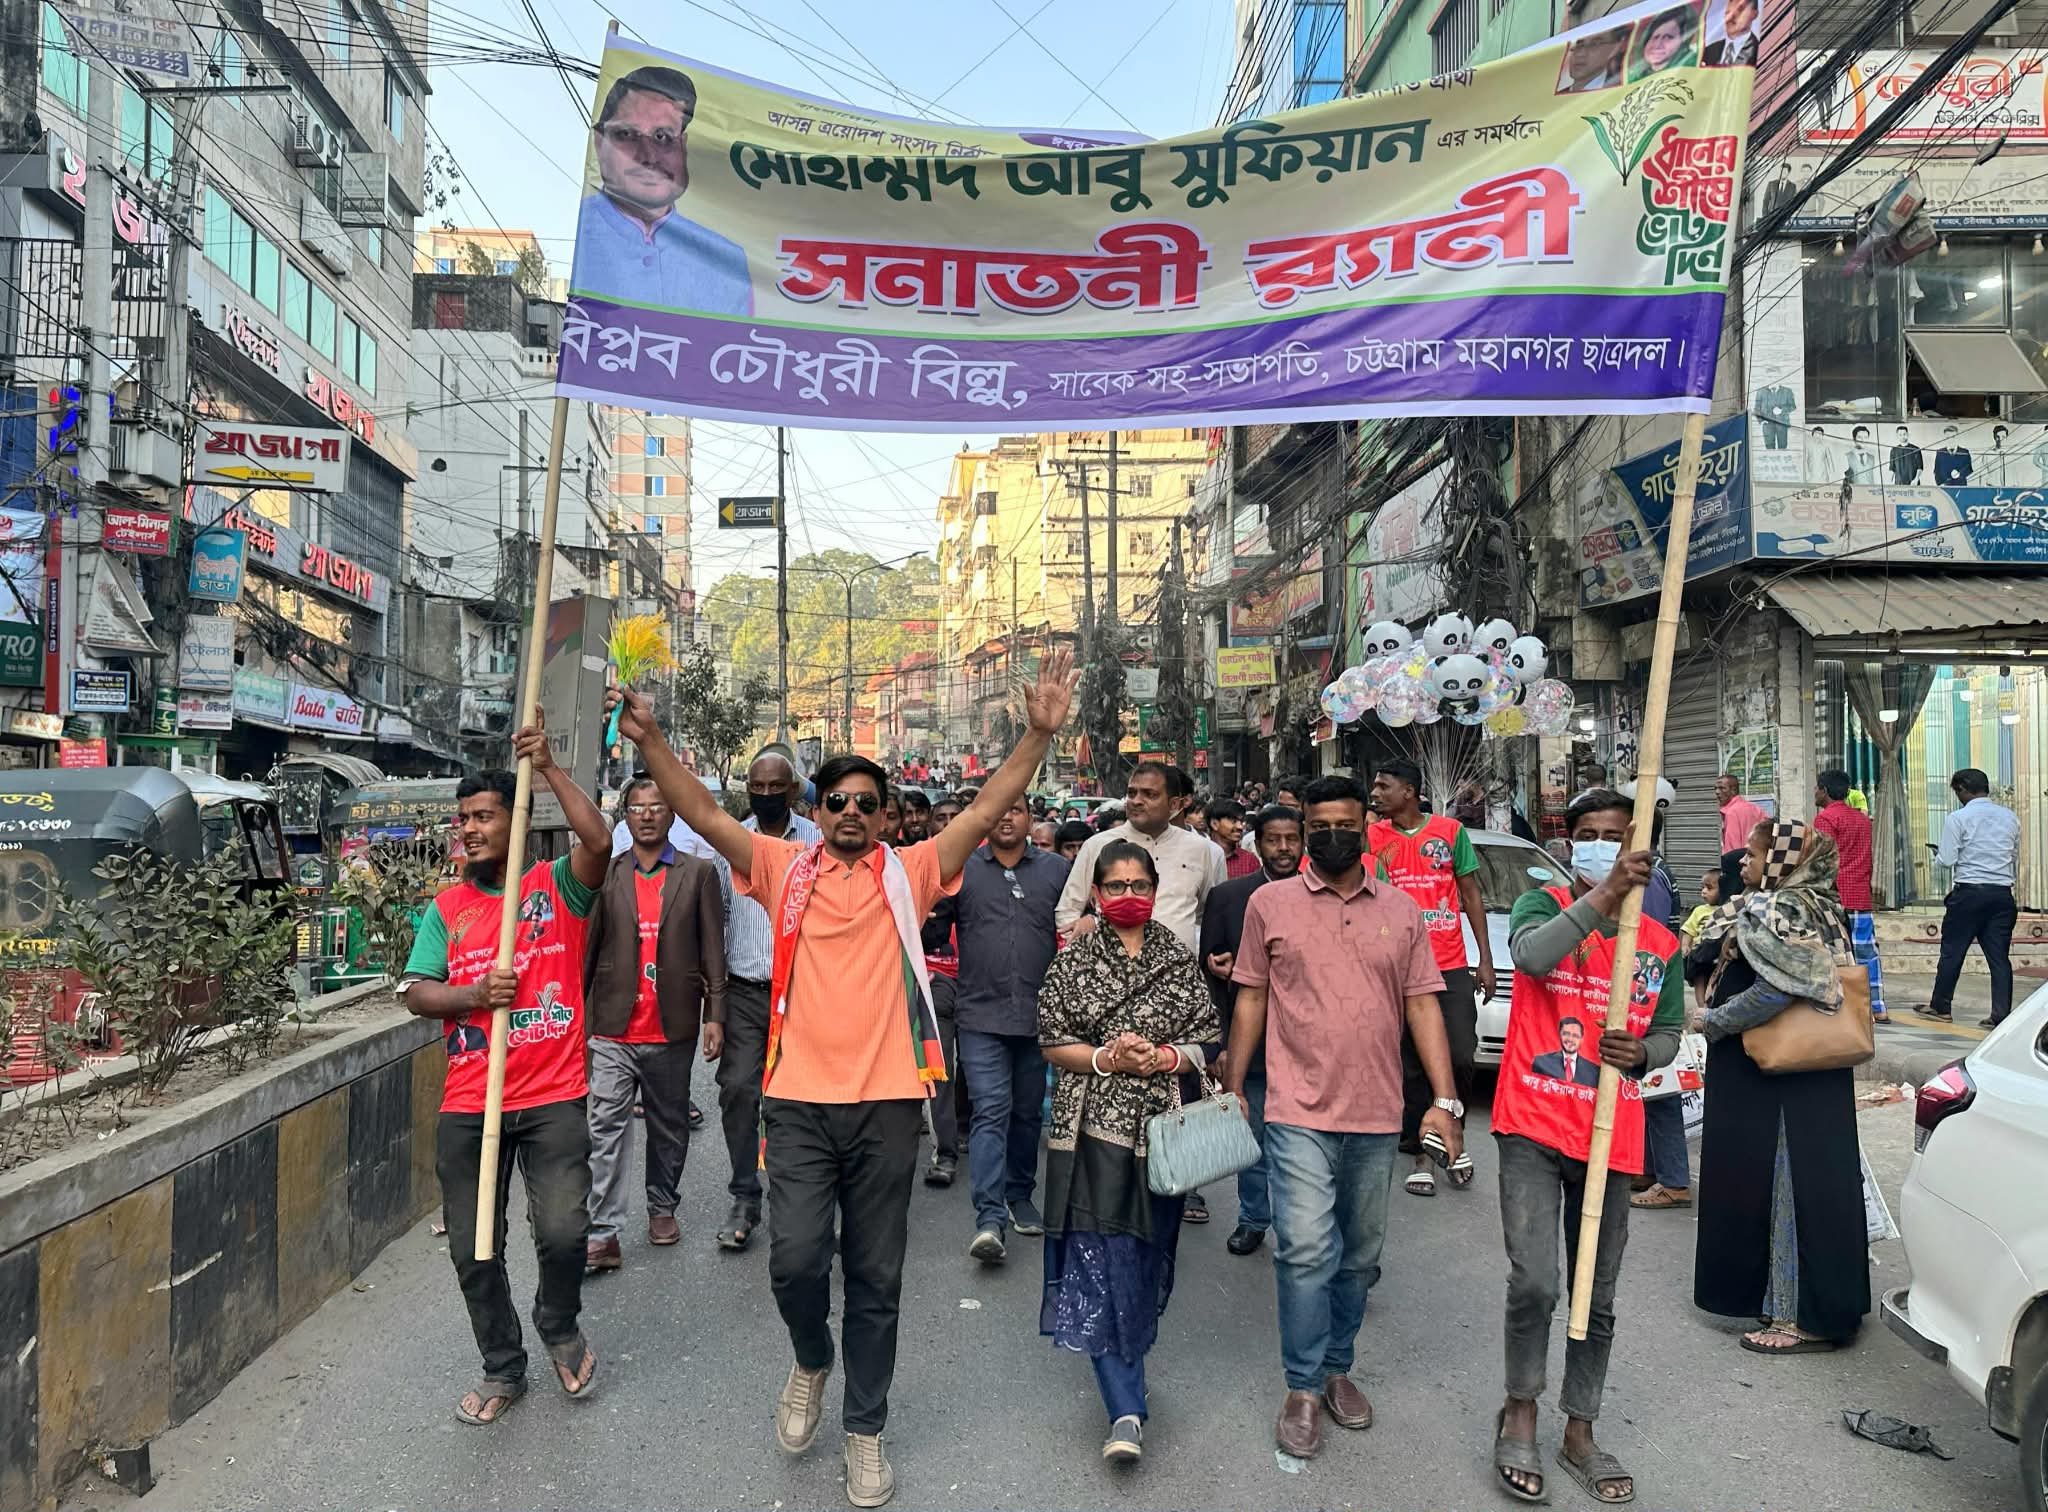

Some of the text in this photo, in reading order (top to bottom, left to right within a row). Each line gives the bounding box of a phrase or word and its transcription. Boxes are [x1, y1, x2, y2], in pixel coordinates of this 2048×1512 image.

[141, 56, 161, 68] 22
[165, 60, 184, 73] 22
[767, 110, 813, 136] আসন্ন
[817, 121, 885, 146] ত্রয়োদশ
[890, 134, 939, 156] সংসদ
[729, 114, 1545, 213] মোহাম্মদ আবু সুফিয়ান এর সমর্থনে
[777, 218, 1212, 315] সনাতনী
[562, 300, 692, 379] বিপ্লব
[710, 329, 892, 406] চৌধুরী
[1049, 369, 1139, 399] সাবেক
[1147, 340, 1330, 395] সহ-সভাপতি,
[1344, 335, 1448, 375] চট্টগ্রাম
[1455, 333, 1574, 373] মহানগর
[307, 366, 375, 446] খাজানা
[205, 431, 341, 463] খাজানা
[107, 514, 170, 533] আল-মিনার
[735, 507, 772, 518] খাজানা
[1900, 507, 1933, 526] লুঙ্গি
[115, 528, 158, 541] টেইলার্স
[303, 542, 374, 602] খাজানা
[294, 695, 326, 719] Bata
[335, 704, 362, 726] বাটা
[1577, 1087, 1596, 1105] ভাই
